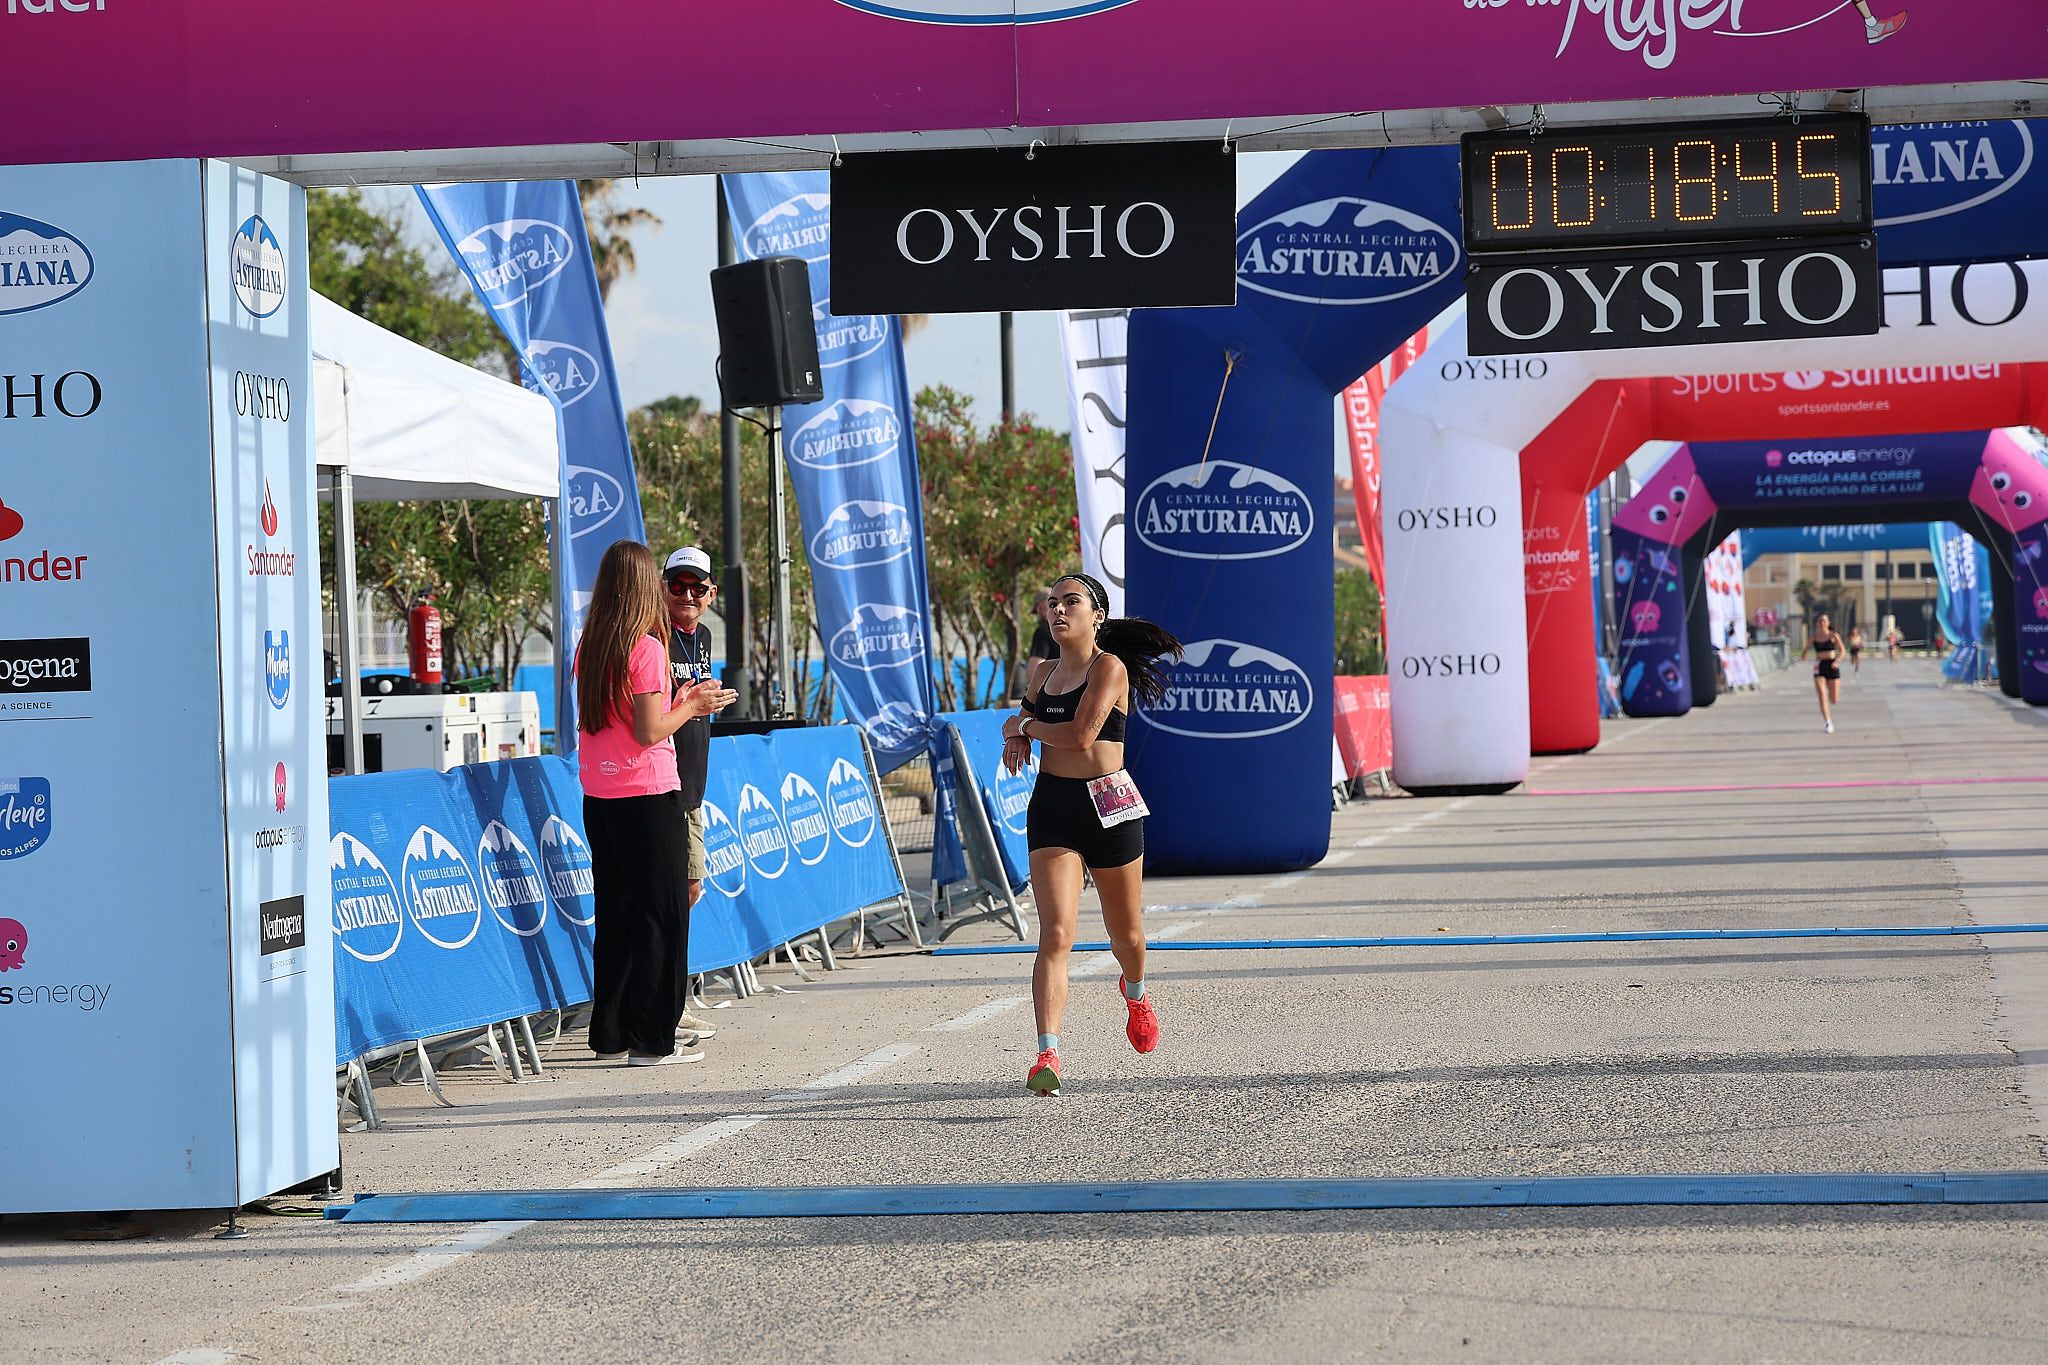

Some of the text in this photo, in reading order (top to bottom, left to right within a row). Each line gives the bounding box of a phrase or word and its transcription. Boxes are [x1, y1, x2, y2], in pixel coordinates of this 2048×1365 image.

[1491, 134, 1841, 230] 00:18:45
[896, 202, 1175, 264] OYSHO
[1276, 233, 1438, 247] CENTRAL LECHERA
[235, 248, 282, 294] ASTURIANA
[1237, 237, 1441, 277] ASTURIANA
[1487, 252, 1857, 340] OYSHO
[1441, 357, 1548, 382] OYSHO
[235, 370, 290, 422] OYSHO
[1777, 399, 1891, 416] sportssantander.es
[1756, 474, 1773, 486] LA
[1833, 471, 1867, 483] PARA
[1869, 469, 1922, 482] CORRER
[1767, 486, 1784, 497] LA
[1787, 485, 1858, 497] VELOCIDAD
[1861, 484, 1879, 494] DE
[1880, 483, 1898, 493] LA
[1900, 481, 1925, 493] LUZ
[1166, 494, 1298, 507] CENTRAL LECHERA
[1142, 497, 1303, 536] ASTURIANA
[1398, 505, 1496, 531] OYSHO
[248, 544, 295, 576] Santander
[1235, 673, 1298, 685] LECHERA
[1402, 652, 1501, 679] OYSHO
[10, 702, 53, 710] SCIENCE
[14, 837, 39, 854] ALPES
[410, 873, 477, 920] ASTURIANA
[484, 865, 544, 909] ASTURIANA
[262, 912, 302, 944] Neutrogena
